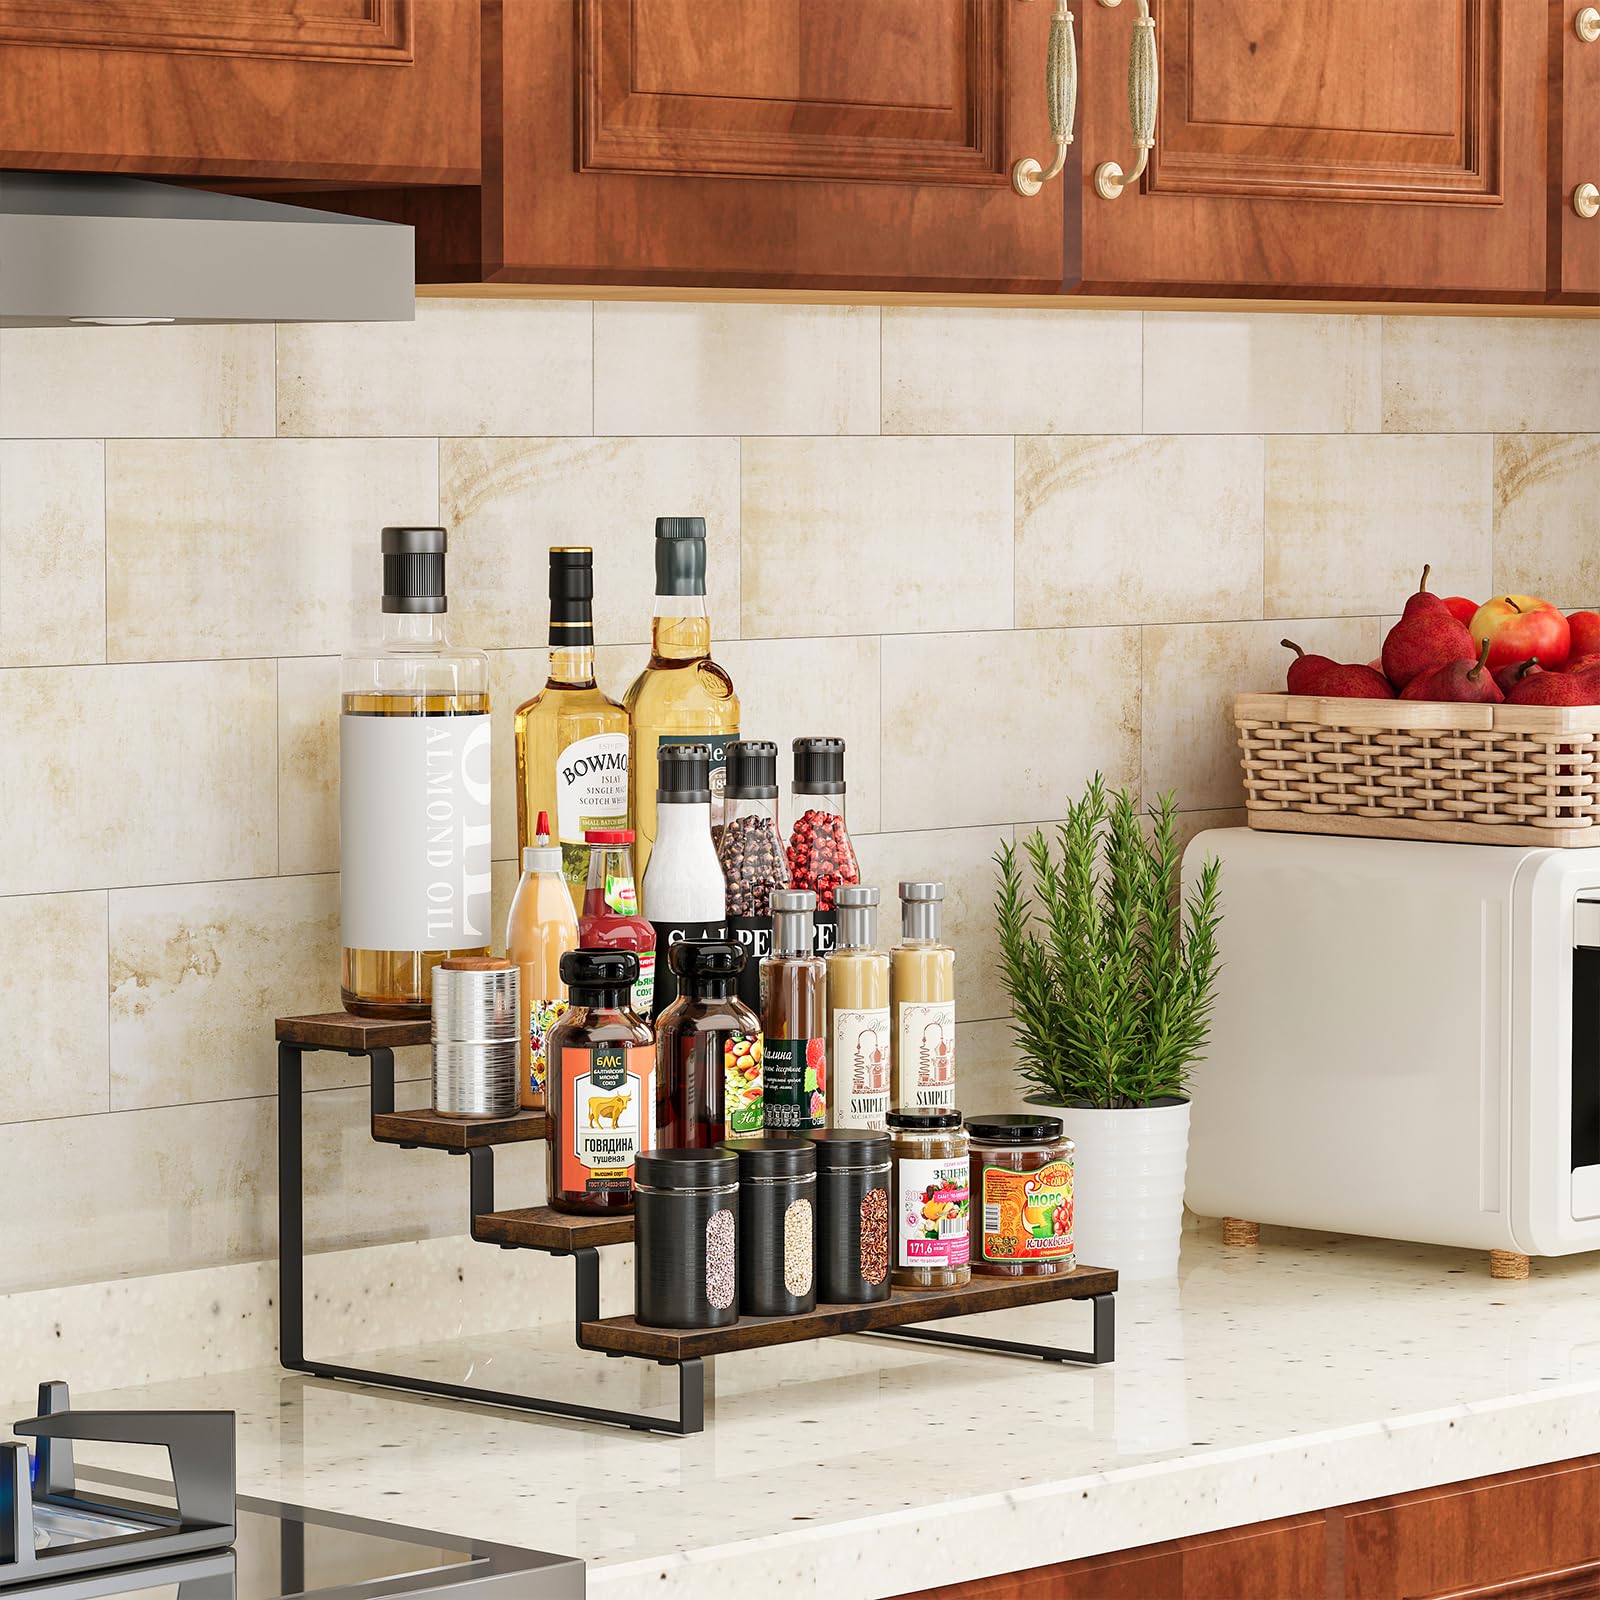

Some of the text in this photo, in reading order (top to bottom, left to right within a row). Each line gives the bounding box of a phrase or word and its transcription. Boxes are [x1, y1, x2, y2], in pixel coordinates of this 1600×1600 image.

[562, 753, 628, 786] BOWMO
[586, 787, 613, 795] SINGLE
[579, 796, 610, 806] SCOTCH
[426, 726, 454, 938] ALMOND OIL
[736, 929, 773, 958] PE
[850, 1098, 883, 1113] SAMPLE
[585, 1138, 634, 1154] ГОВЯДИНА
[592, 1155, 625, 1165] тушеная
[1028, 1193, 1062, 1208] МОРС
[909, 1242, 933, 1255] 171,6
